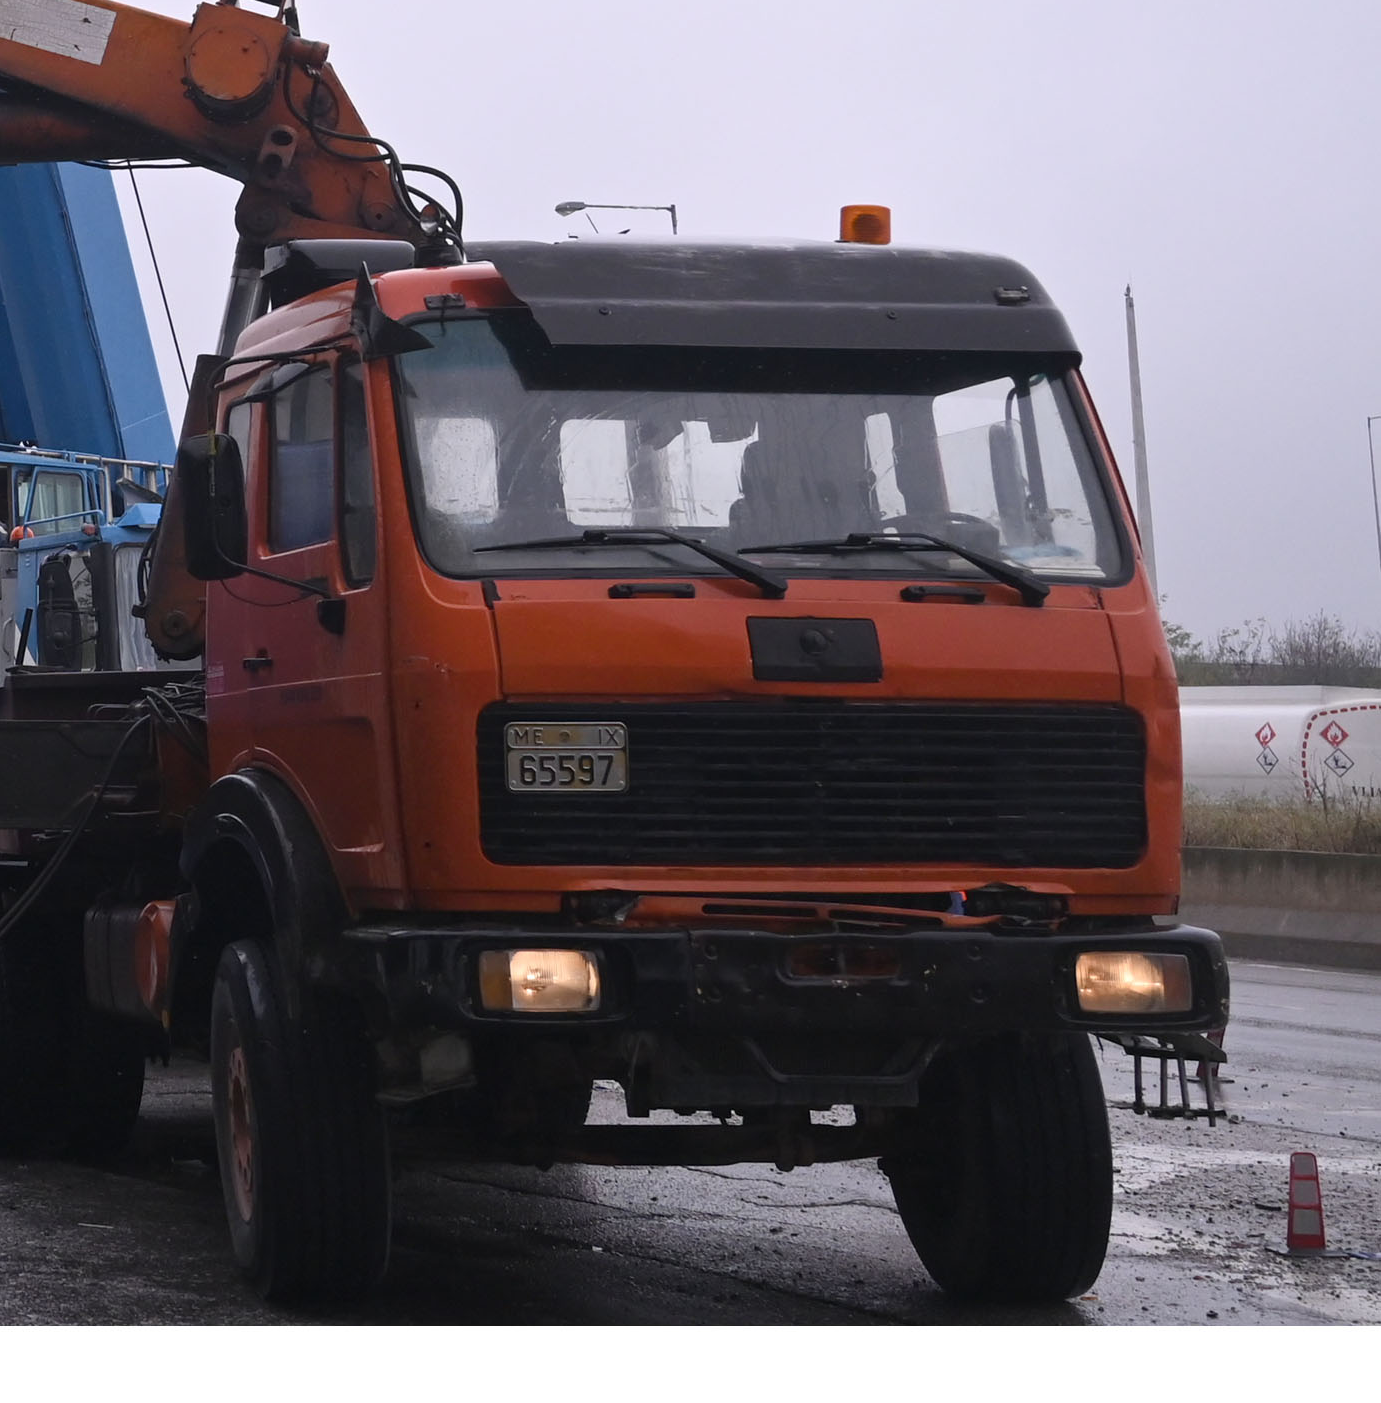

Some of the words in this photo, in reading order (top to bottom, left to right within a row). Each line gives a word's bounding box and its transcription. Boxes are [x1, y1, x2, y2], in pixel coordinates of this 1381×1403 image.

[513, 727, 544, 745] ME
[598, 727, 620, 745] IX
[518, 754, 615, 786] 65597
